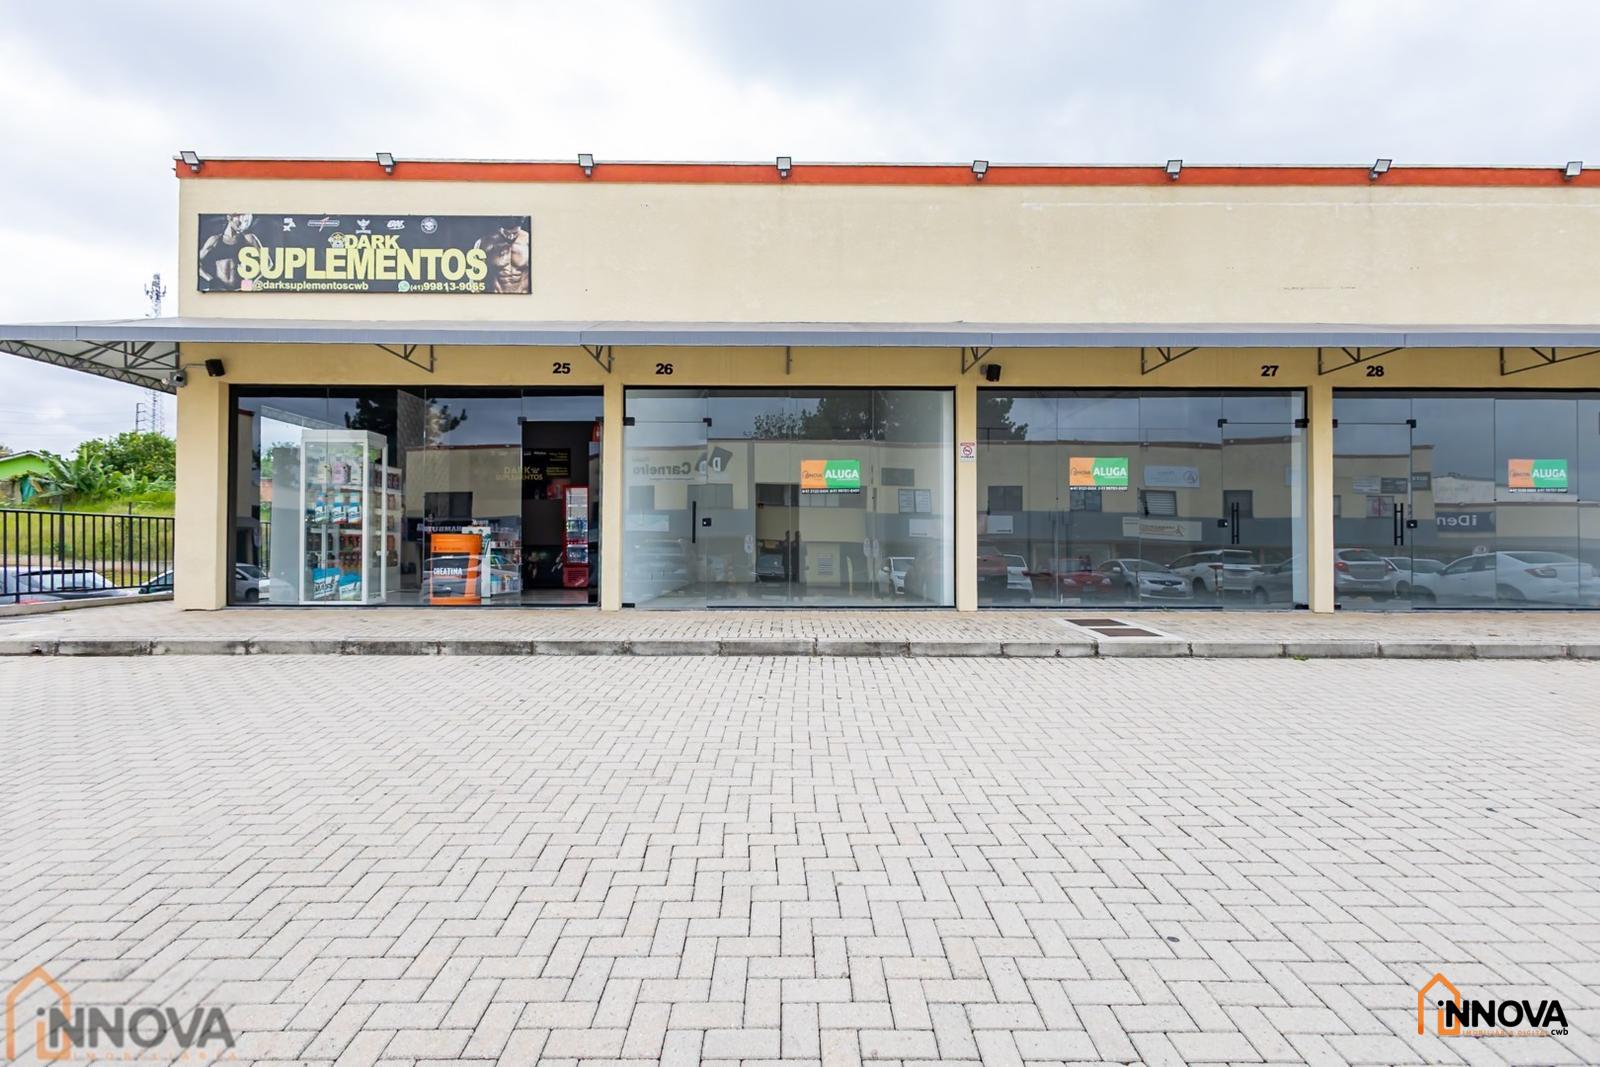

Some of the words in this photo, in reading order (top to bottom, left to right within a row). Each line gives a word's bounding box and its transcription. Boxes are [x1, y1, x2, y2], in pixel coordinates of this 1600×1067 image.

[344, 234, 400, 250] DARK
[237, 246, 488, 281] SUPLEMENTOS
[254, 280, 369, 292] @darksuplementoscwb
[552, 362, 571, 374] 25
[655, 363, 674, 375] 26
[1261, 365, 1280, 377] 27
[1366, 365, 1385, 377] 28
[824, 469, 860, 479] ALUGA
[1093, 466, 1127, 476] ALUGA
[1532, 468, 1567, 478] ALUGA
[433, 567, 463, 576] CREATINA
